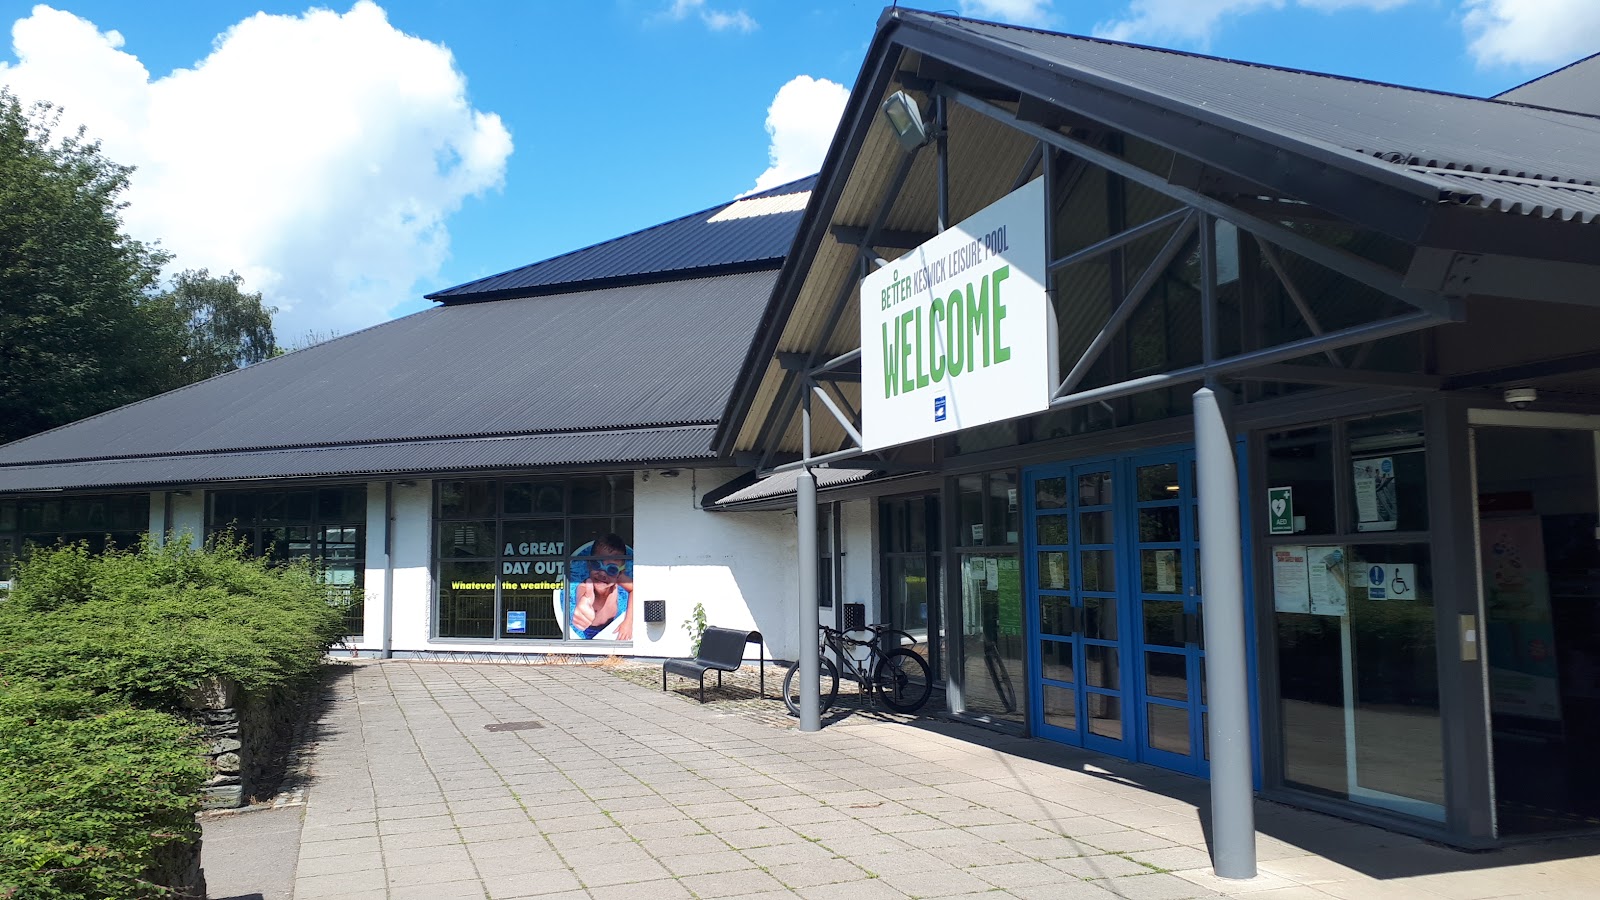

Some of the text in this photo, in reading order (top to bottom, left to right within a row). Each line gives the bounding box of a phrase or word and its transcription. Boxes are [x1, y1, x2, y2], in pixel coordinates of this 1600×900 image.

[881, 225, 1009, 311] BETTER KESWICK LEISURE POOL
[882, 265, 1011, 399] WELCOME
[503, 542, 564, 555] A GREAT
[503, 562, 564, 574] DAY OUT
[451, 581, 564, 590] Whatever the weather!
